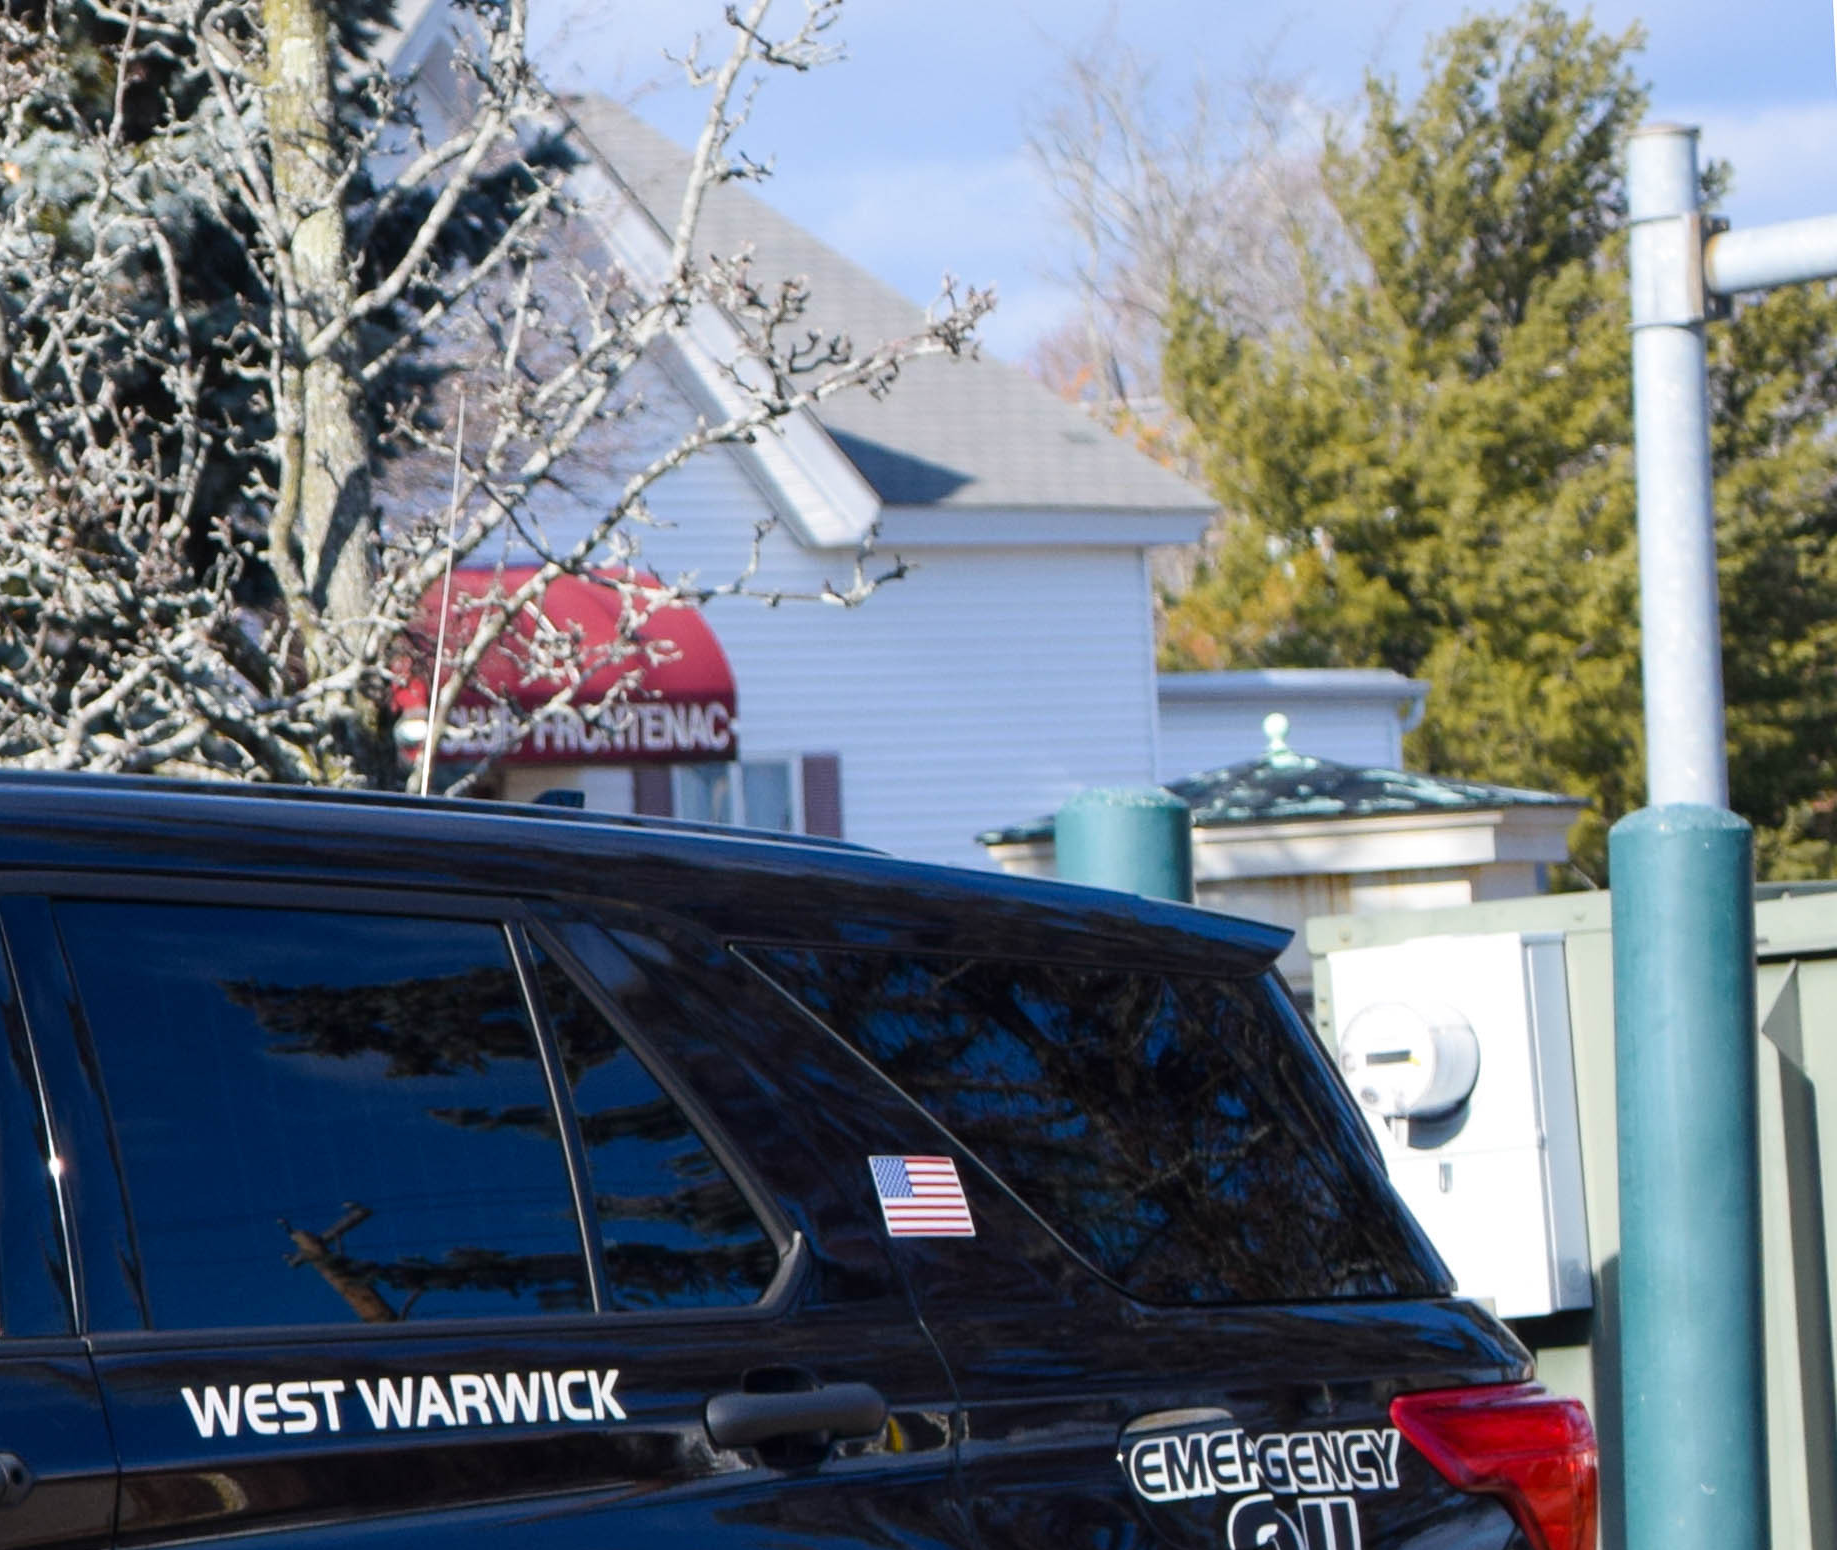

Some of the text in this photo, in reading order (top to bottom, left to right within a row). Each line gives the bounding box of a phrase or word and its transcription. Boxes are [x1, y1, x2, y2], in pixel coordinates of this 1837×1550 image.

[180, 1369, 627, 1438] WEST WARWICK
[1130, 1428, 1401, 1502] EMERGENCY
